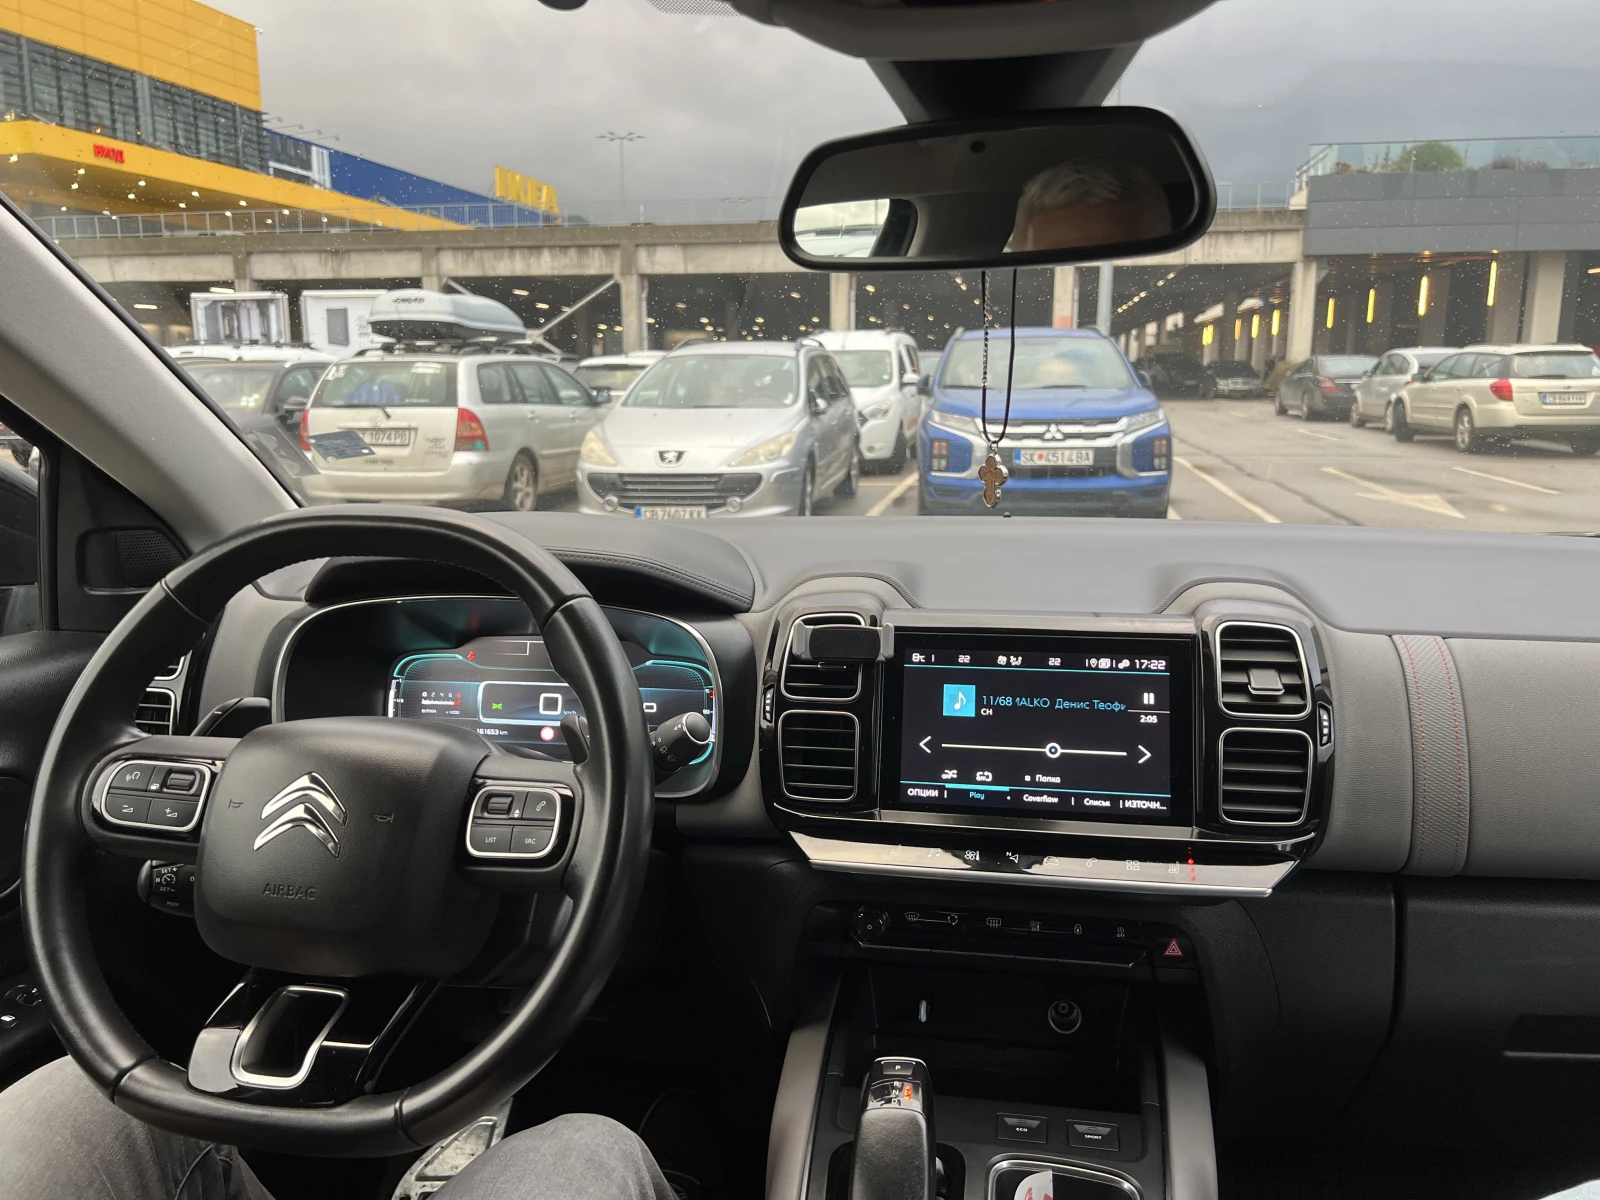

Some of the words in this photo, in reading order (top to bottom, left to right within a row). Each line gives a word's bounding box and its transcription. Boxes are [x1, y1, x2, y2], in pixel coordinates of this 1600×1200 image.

[494, 165, 560, 214] IKEA
[370, 431, 393, 443] 1074
[1022, 451, 1036, 464] SK
[958, 655, 971, 663] 22
[1048, 658, 1061, 666] 22
[1135, 659, 1166, 670] 17:22
[982, 695, 1013, 707] 11/68
[1055, 698, 1090, 709] Денис
[1140, 714, 1158, 723] 2:05
[1035, 774, 1061, 783] Папка
[907, 788, 939, 797] ОПЦИИ
[969, 791, 985, 800] Play
[1023, 794, 1059, 804] Coverflow
[262, 883, 317, 900] AIRBAG
